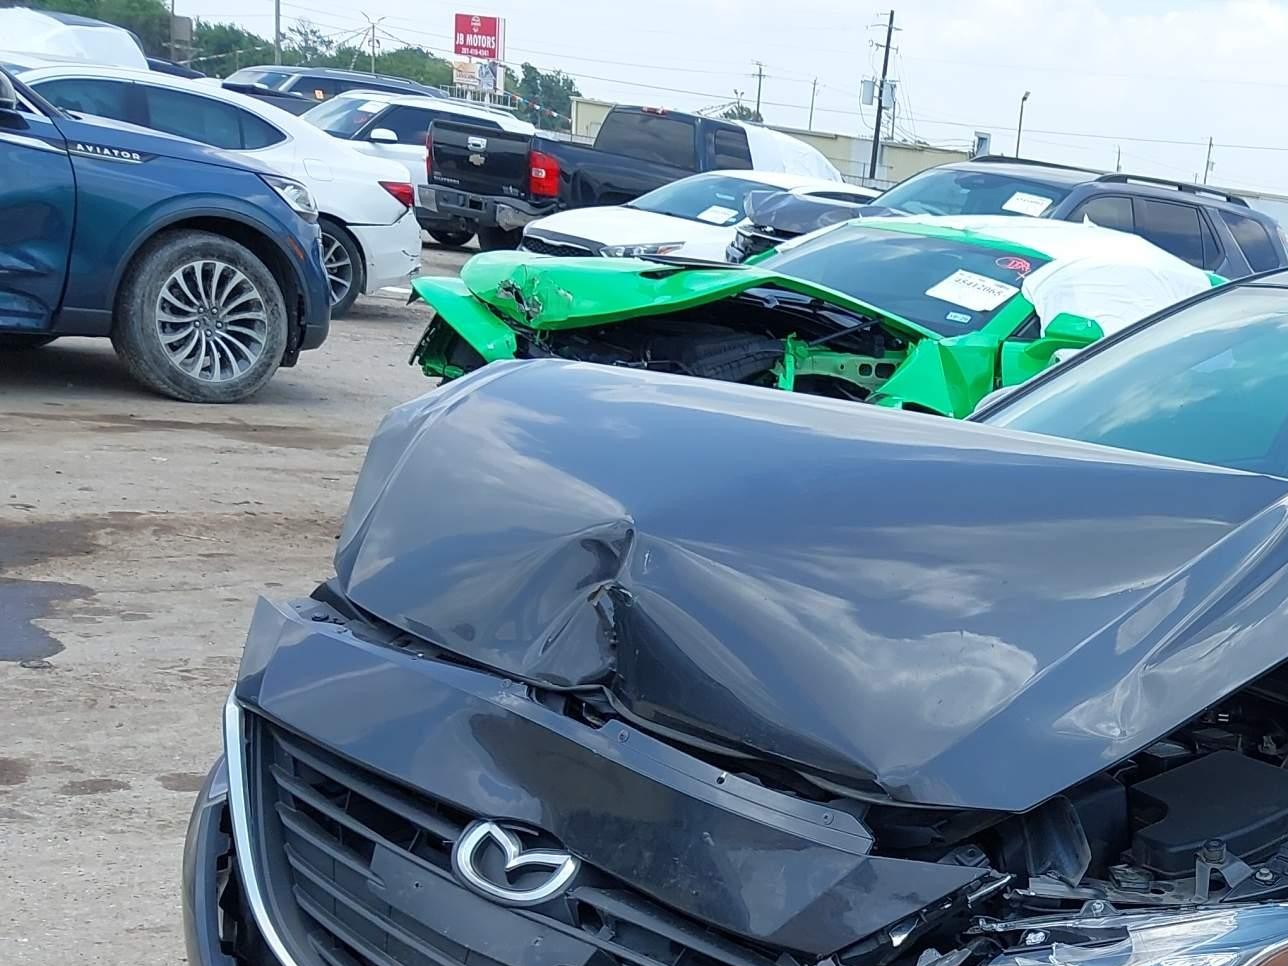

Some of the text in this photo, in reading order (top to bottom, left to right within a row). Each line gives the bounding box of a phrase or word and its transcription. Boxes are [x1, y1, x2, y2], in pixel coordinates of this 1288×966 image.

[456, 32, 496, 49] JB MOTORS
[76, 143, 141, 160] AVIATOR
